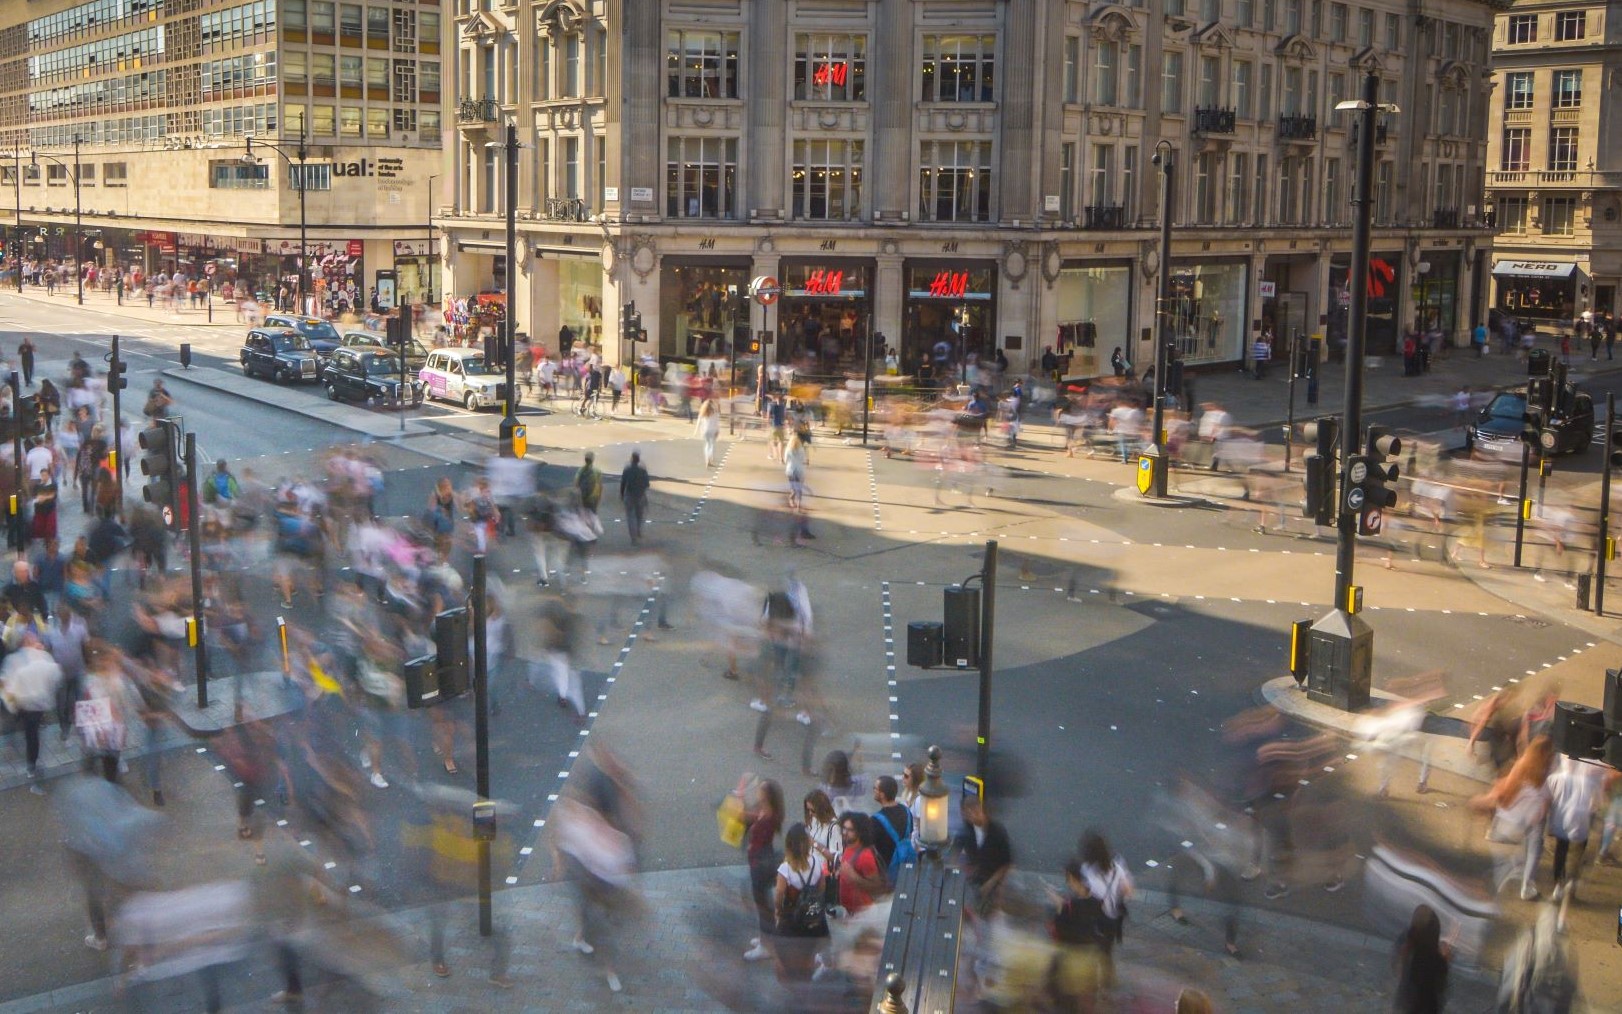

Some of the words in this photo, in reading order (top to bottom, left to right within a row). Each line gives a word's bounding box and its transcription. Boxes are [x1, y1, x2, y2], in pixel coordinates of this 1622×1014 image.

[332, 158, 374, 177] ual:
[699, 239, 715, 250] H&M
[820, 240, 836, 251] H&M
[942, 241, 958, 253] H&M
[804, 269, 843, 295] H&M
[930, 272, 968, 297] H&M
